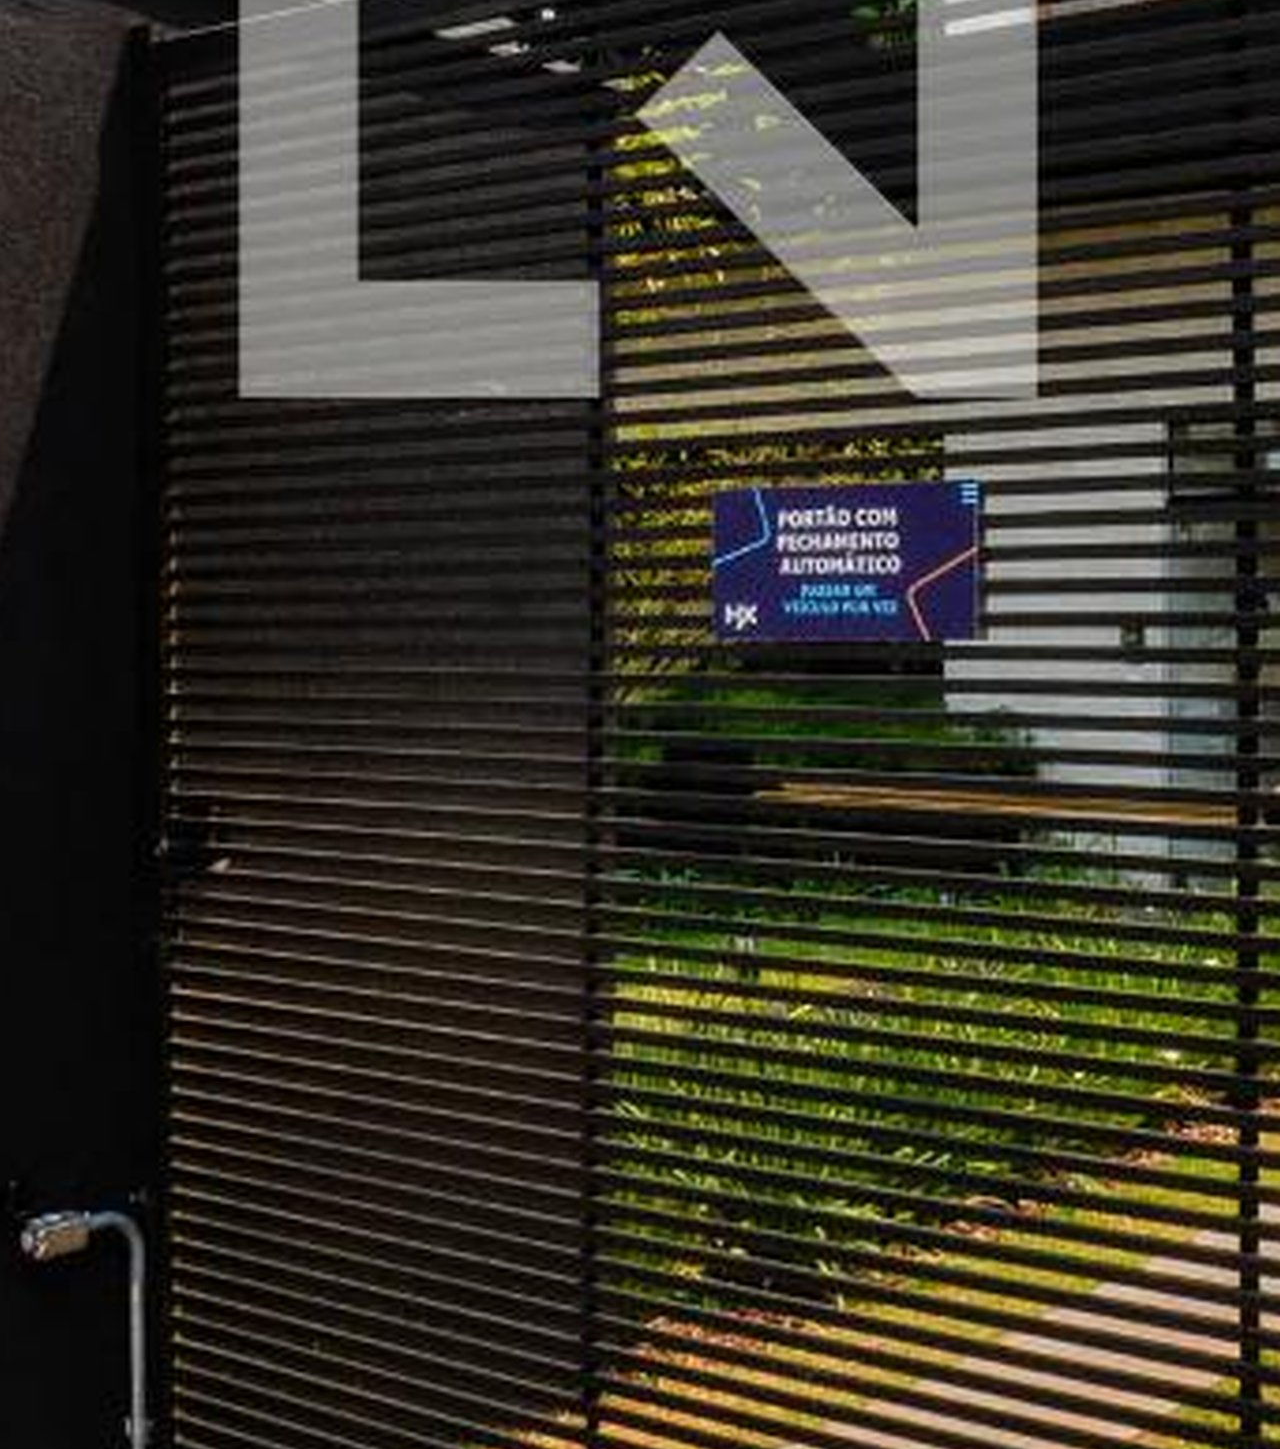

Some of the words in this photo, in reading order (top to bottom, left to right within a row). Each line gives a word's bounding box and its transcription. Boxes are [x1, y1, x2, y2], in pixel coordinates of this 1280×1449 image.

[777, 505, 851, 529] PORTÃO
[854, 507, 899, 527] COM
[777, 531, 901, 552] FECHAMENTO
[779, 551, 902, 575] AUTOMÁTICO
[724, 603, 758, 630] HX
